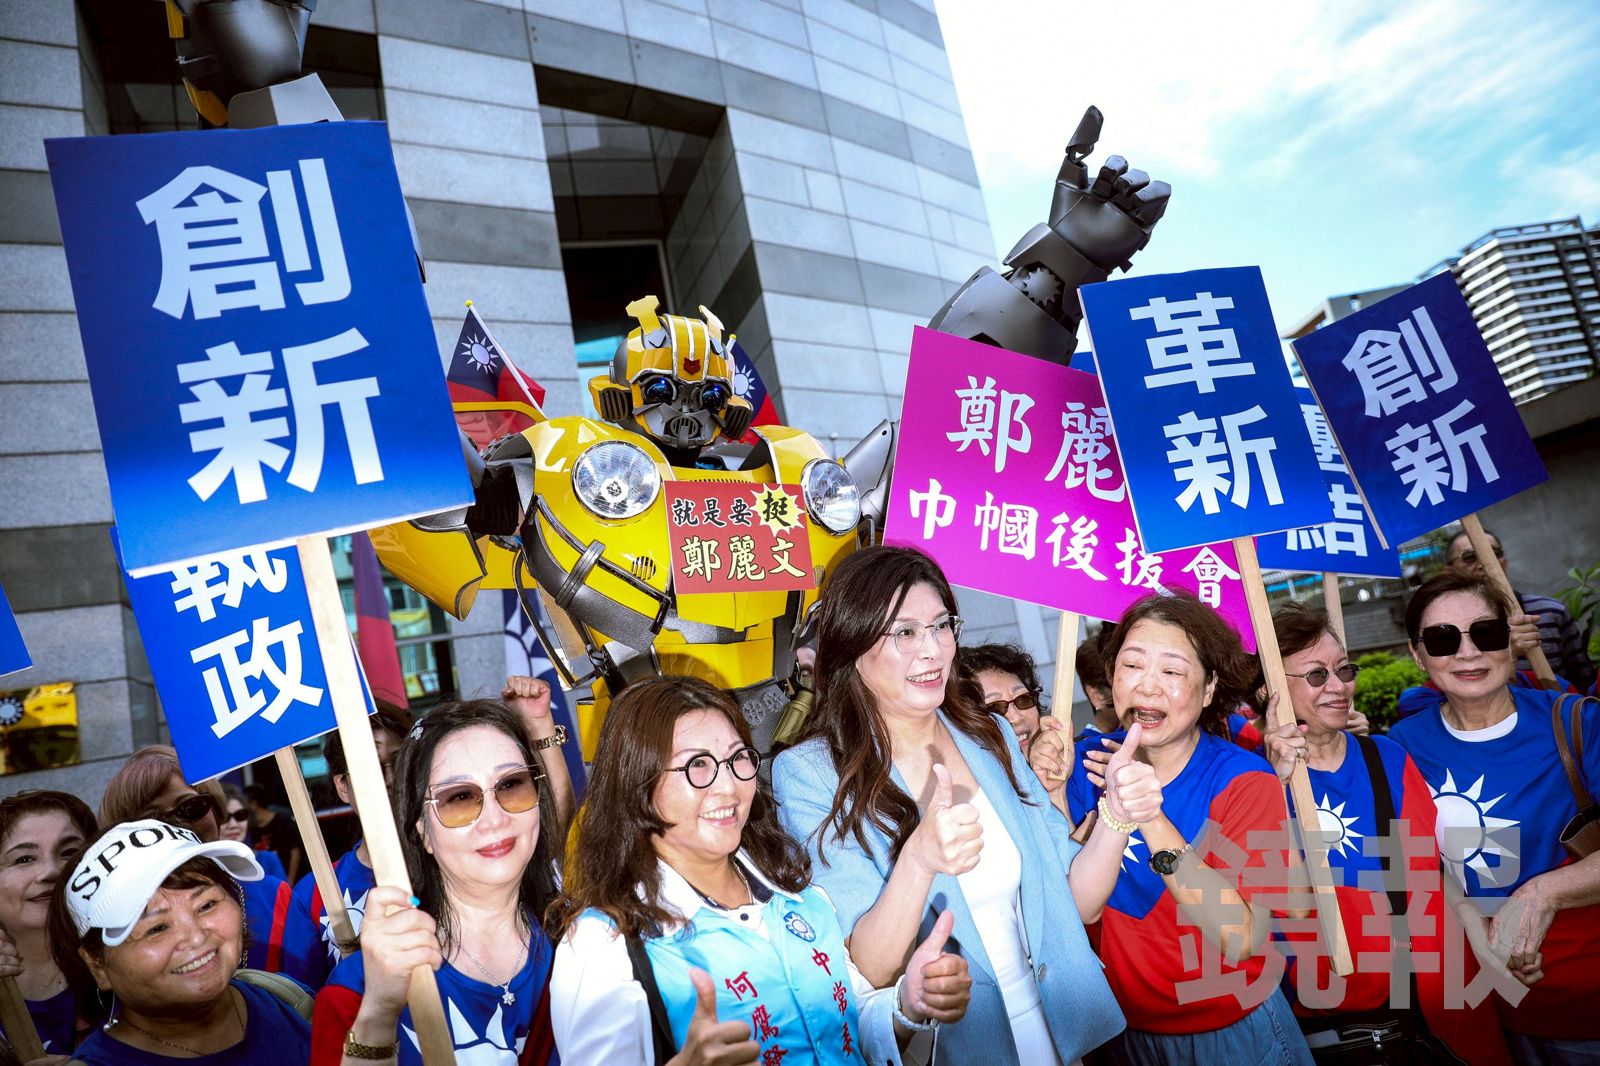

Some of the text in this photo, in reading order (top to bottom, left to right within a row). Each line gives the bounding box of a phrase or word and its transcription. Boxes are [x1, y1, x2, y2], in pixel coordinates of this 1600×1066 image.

[135, 158, 385, 505] 創新
[1129, 291, 1285, 515] 革新
[1341, 305, 1500, 511] 創新
[671, 490, 791, 527] 就是要挺
[681, 534, 807, 582] 鄭麗文
[908, 478, 1241, 609] 巾幗後援會
